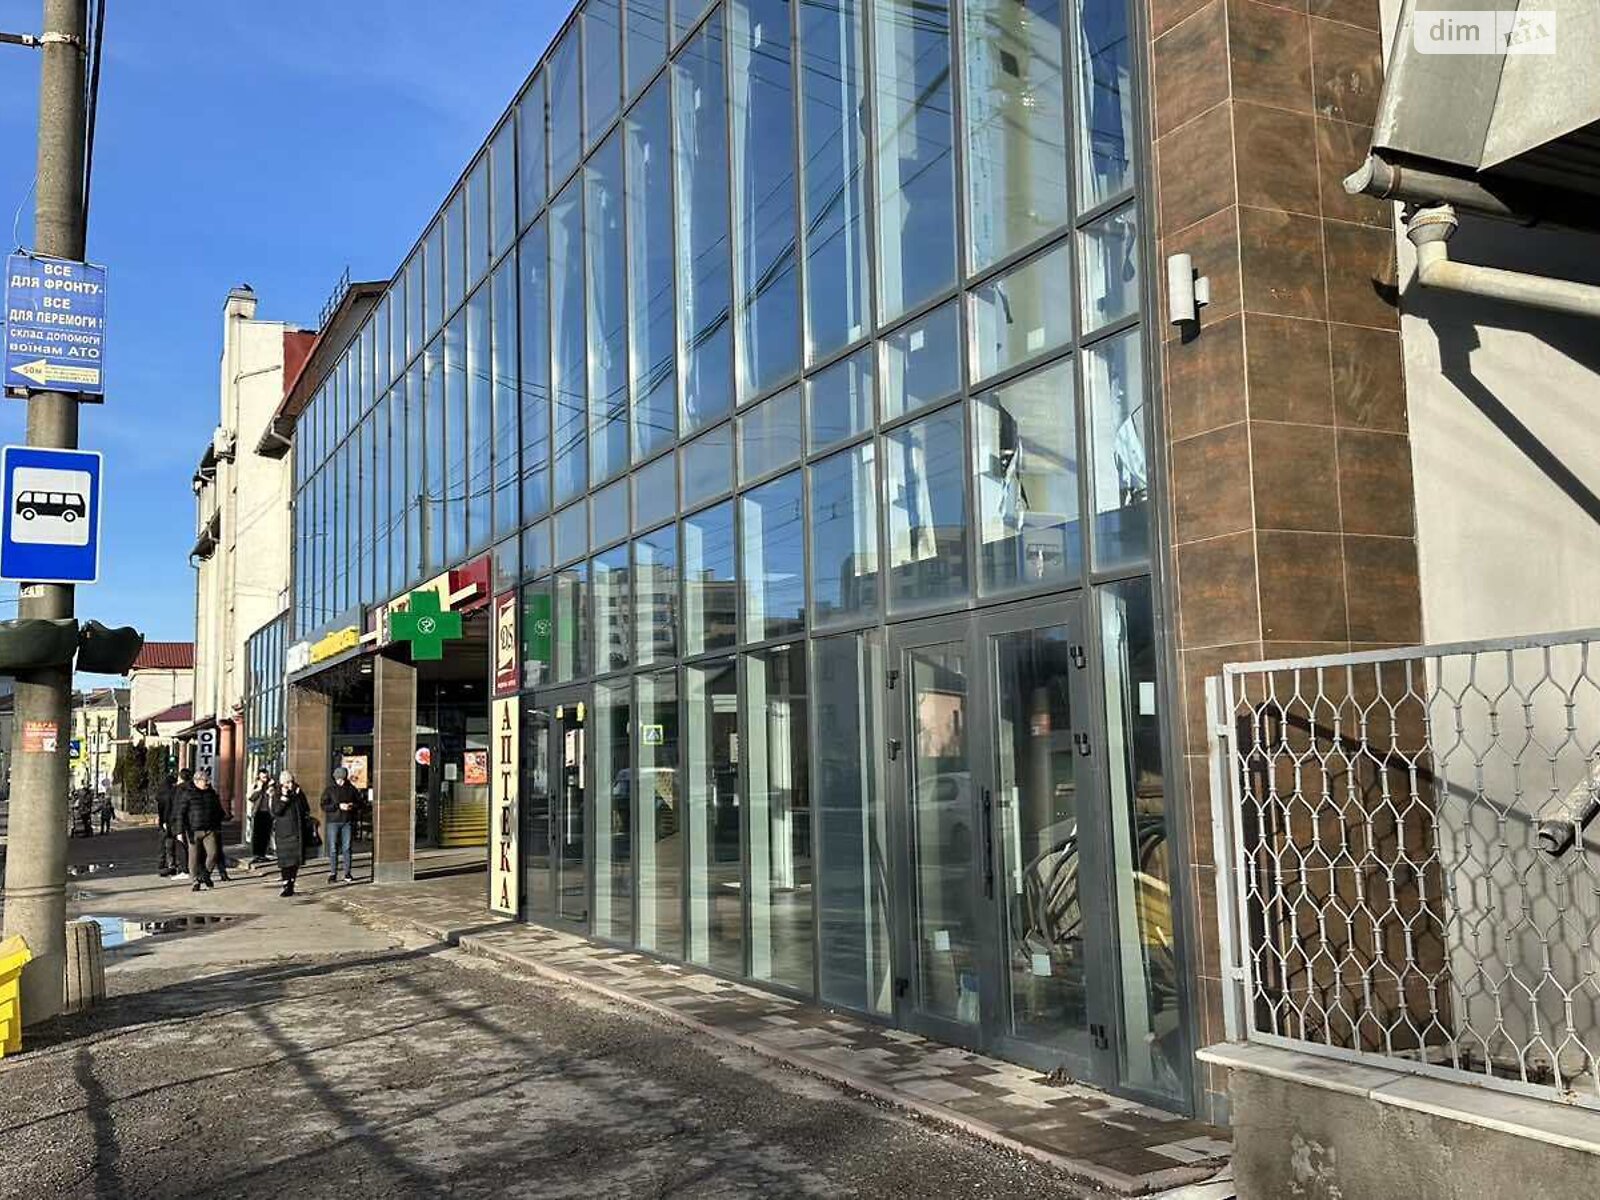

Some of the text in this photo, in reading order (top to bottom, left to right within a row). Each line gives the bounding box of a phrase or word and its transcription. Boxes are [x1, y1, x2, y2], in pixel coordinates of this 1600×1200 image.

[44, 264, 72, 277] ВСЕ
[11, 275, 40, 289] ДЛЯ
[43, 297, 71, 310] ВСЕ
[9, 309, 33, 322] ДЛЯ
[36, 311, 97, 328] ПЕРЕМОГИ
[46, 332, 100, 346] допомоги
[67, 346, 100, 359] АТО
[500, 700, 512, 909] АПТЕКА
